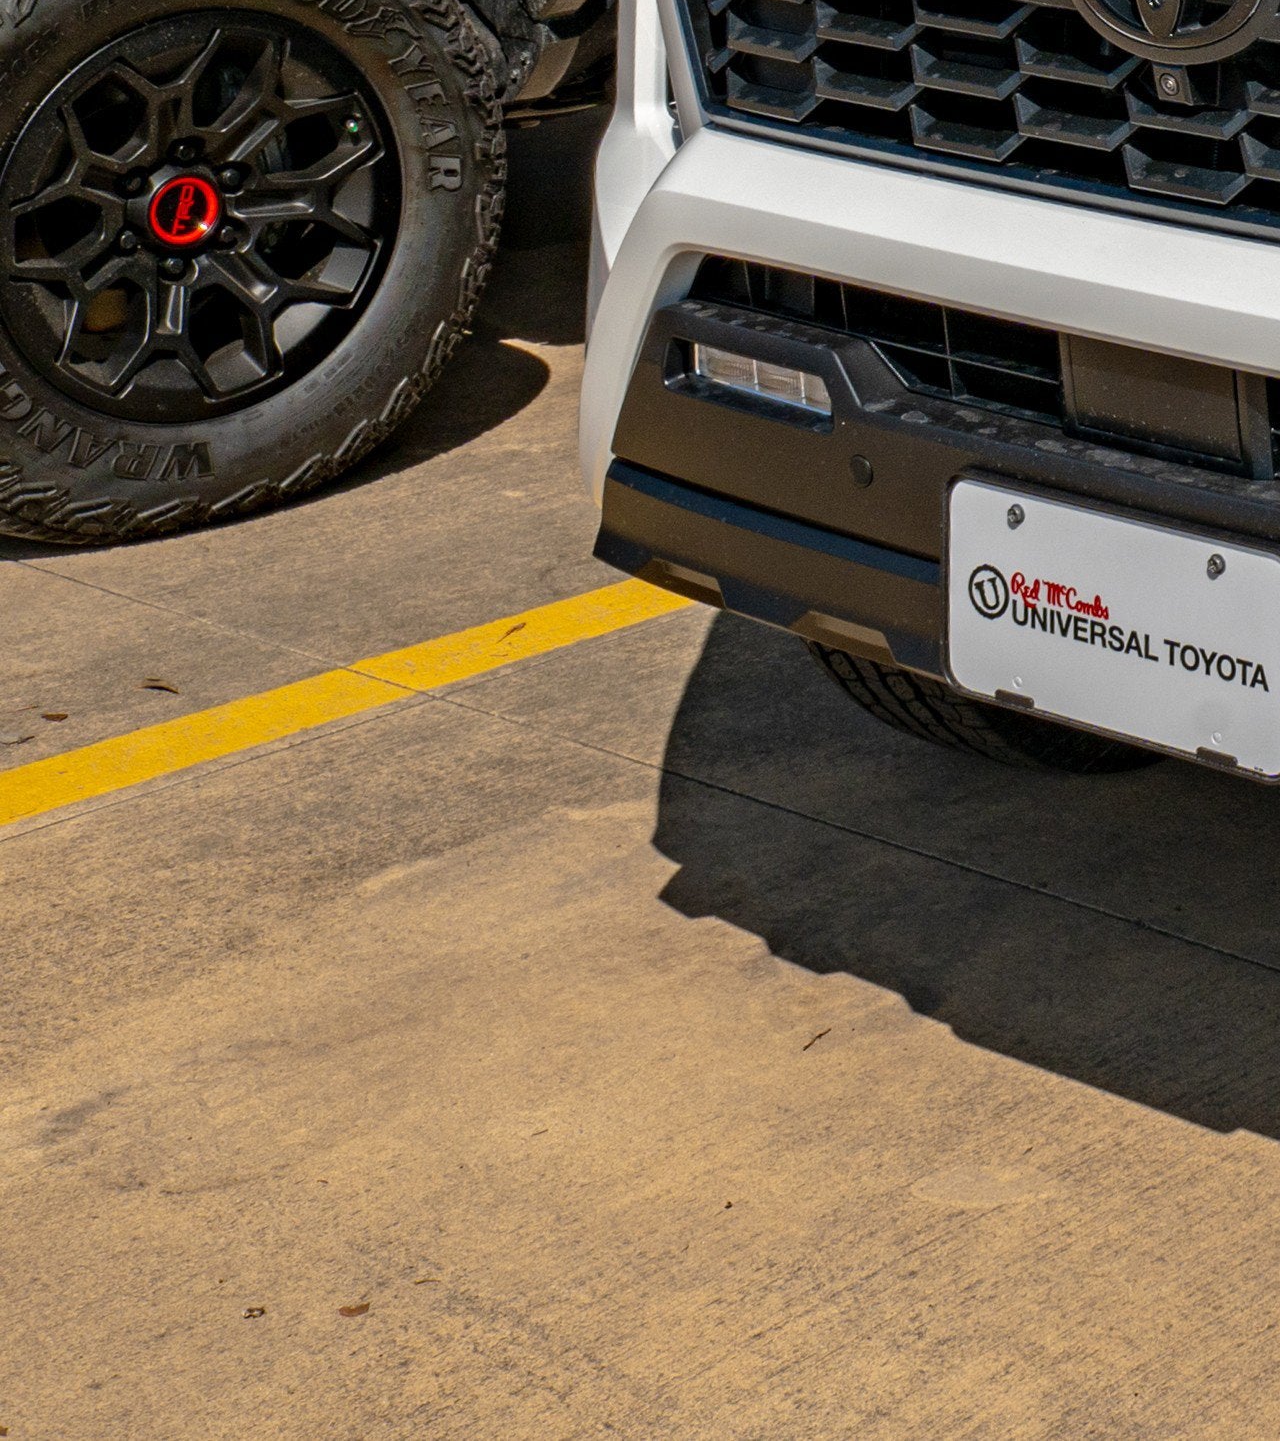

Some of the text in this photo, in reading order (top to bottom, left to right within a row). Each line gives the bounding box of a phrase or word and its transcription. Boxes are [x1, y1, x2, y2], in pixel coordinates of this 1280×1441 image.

[1011, 572, 1109, 620] Red McCombs
[1012, 599, 1270, 692] UNIVERSAL TOYOTA
